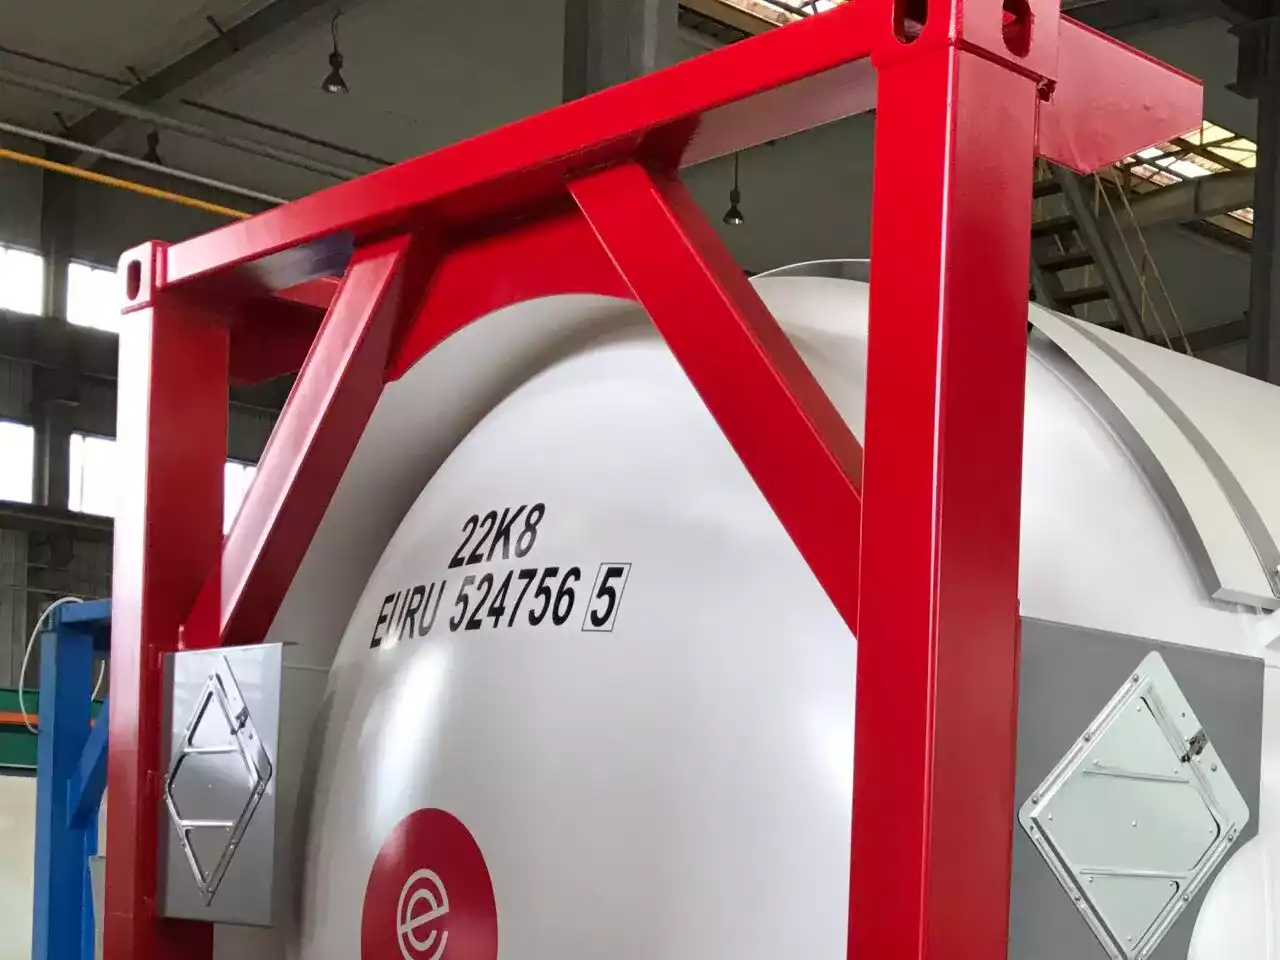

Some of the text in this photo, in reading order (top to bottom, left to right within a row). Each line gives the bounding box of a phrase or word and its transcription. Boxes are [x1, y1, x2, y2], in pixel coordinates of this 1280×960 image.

[447, 503, 546, 569] 22K8
[370, 566, 625, 649] EURU 524756 5
